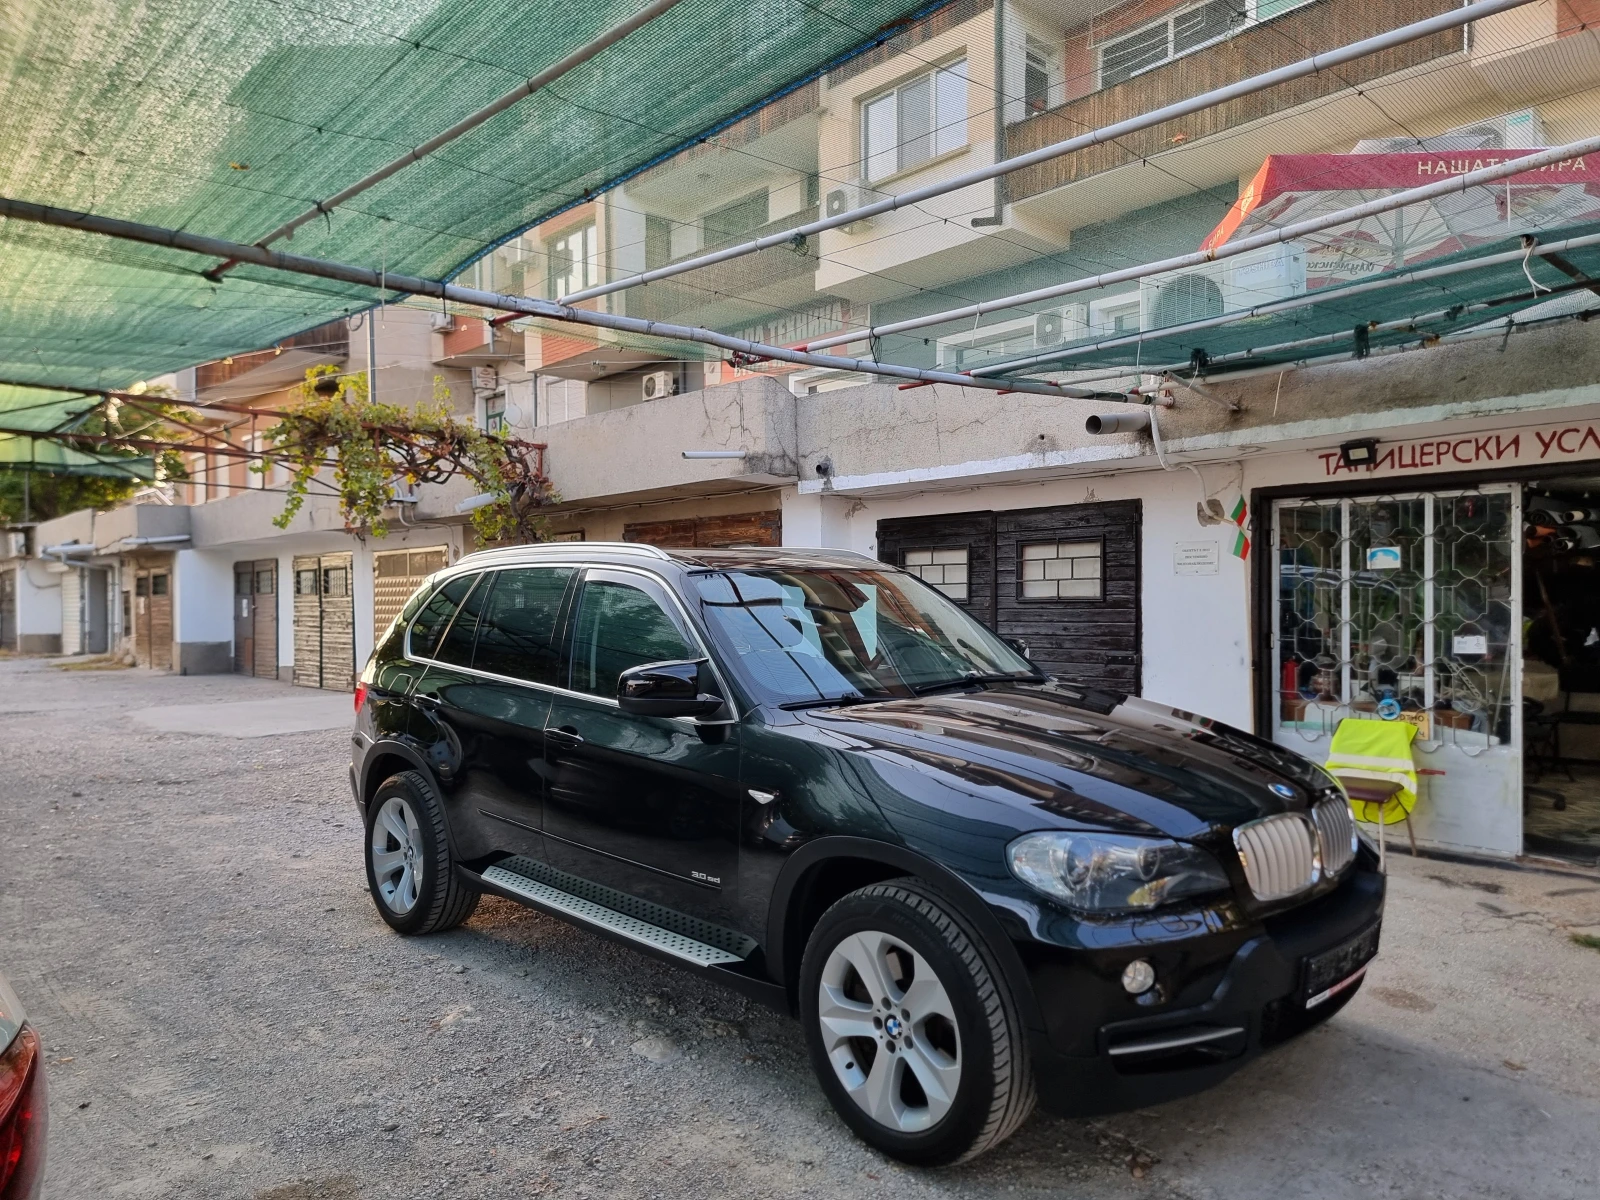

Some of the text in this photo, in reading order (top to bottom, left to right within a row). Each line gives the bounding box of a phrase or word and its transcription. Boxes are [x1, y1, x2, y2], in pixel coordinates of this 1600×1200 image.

[1417, 155, 1587, 175] НАШАТ ИРА
[1238, 258, 1285, 276] TOSHIBA
